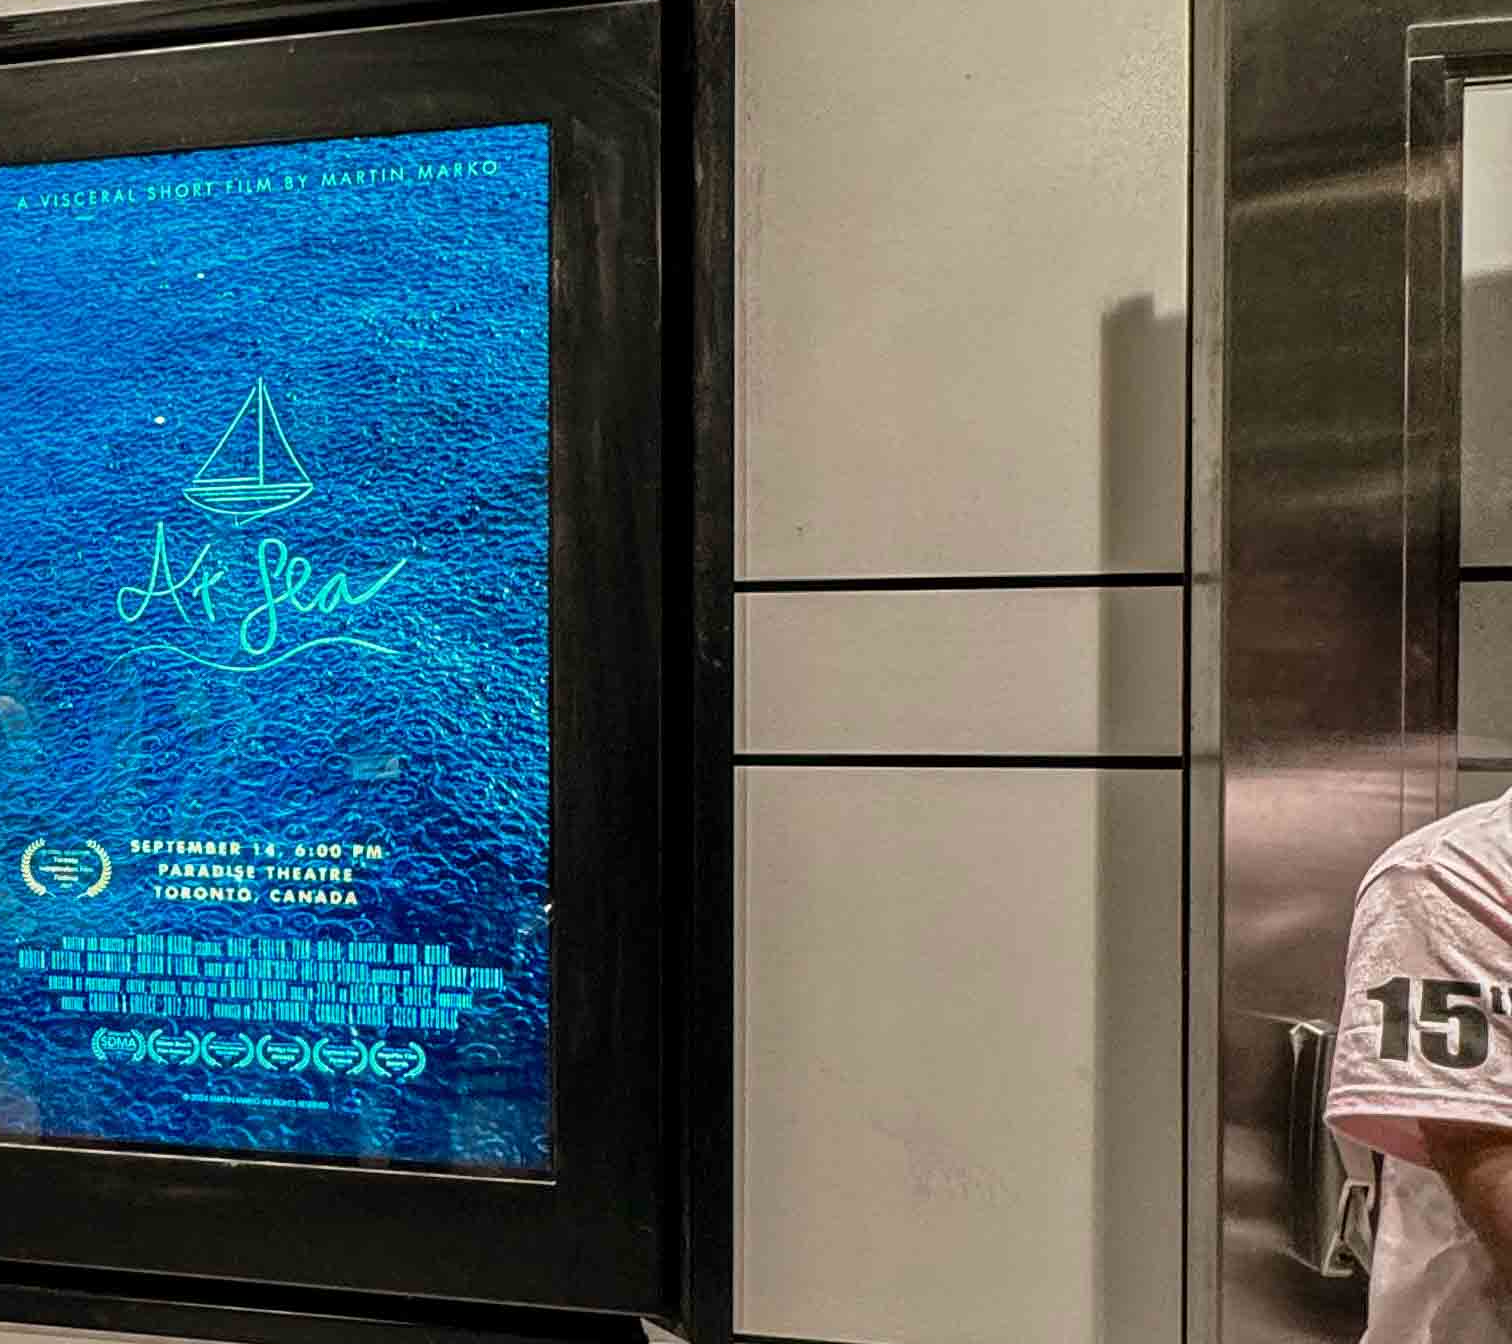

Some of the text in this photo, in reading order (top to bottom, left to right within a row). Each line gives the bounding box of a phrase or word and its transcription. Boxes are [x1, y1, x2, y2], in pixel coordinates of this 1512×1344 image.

[18, 160, 497, 209] A VISCERAL SHORT FILM BY MARTIN MARKO
[117, 520, 408, 655] At Sea
[130, 839, 241, 856] SEPTEMBER
[295, 843, 342, 858] 6:00
[352, 844, 383, 860] PM
[158, 863, 353, 882] PARADISE THEATRE
[154, 885, 358, 905] TORONTO, CANADA
